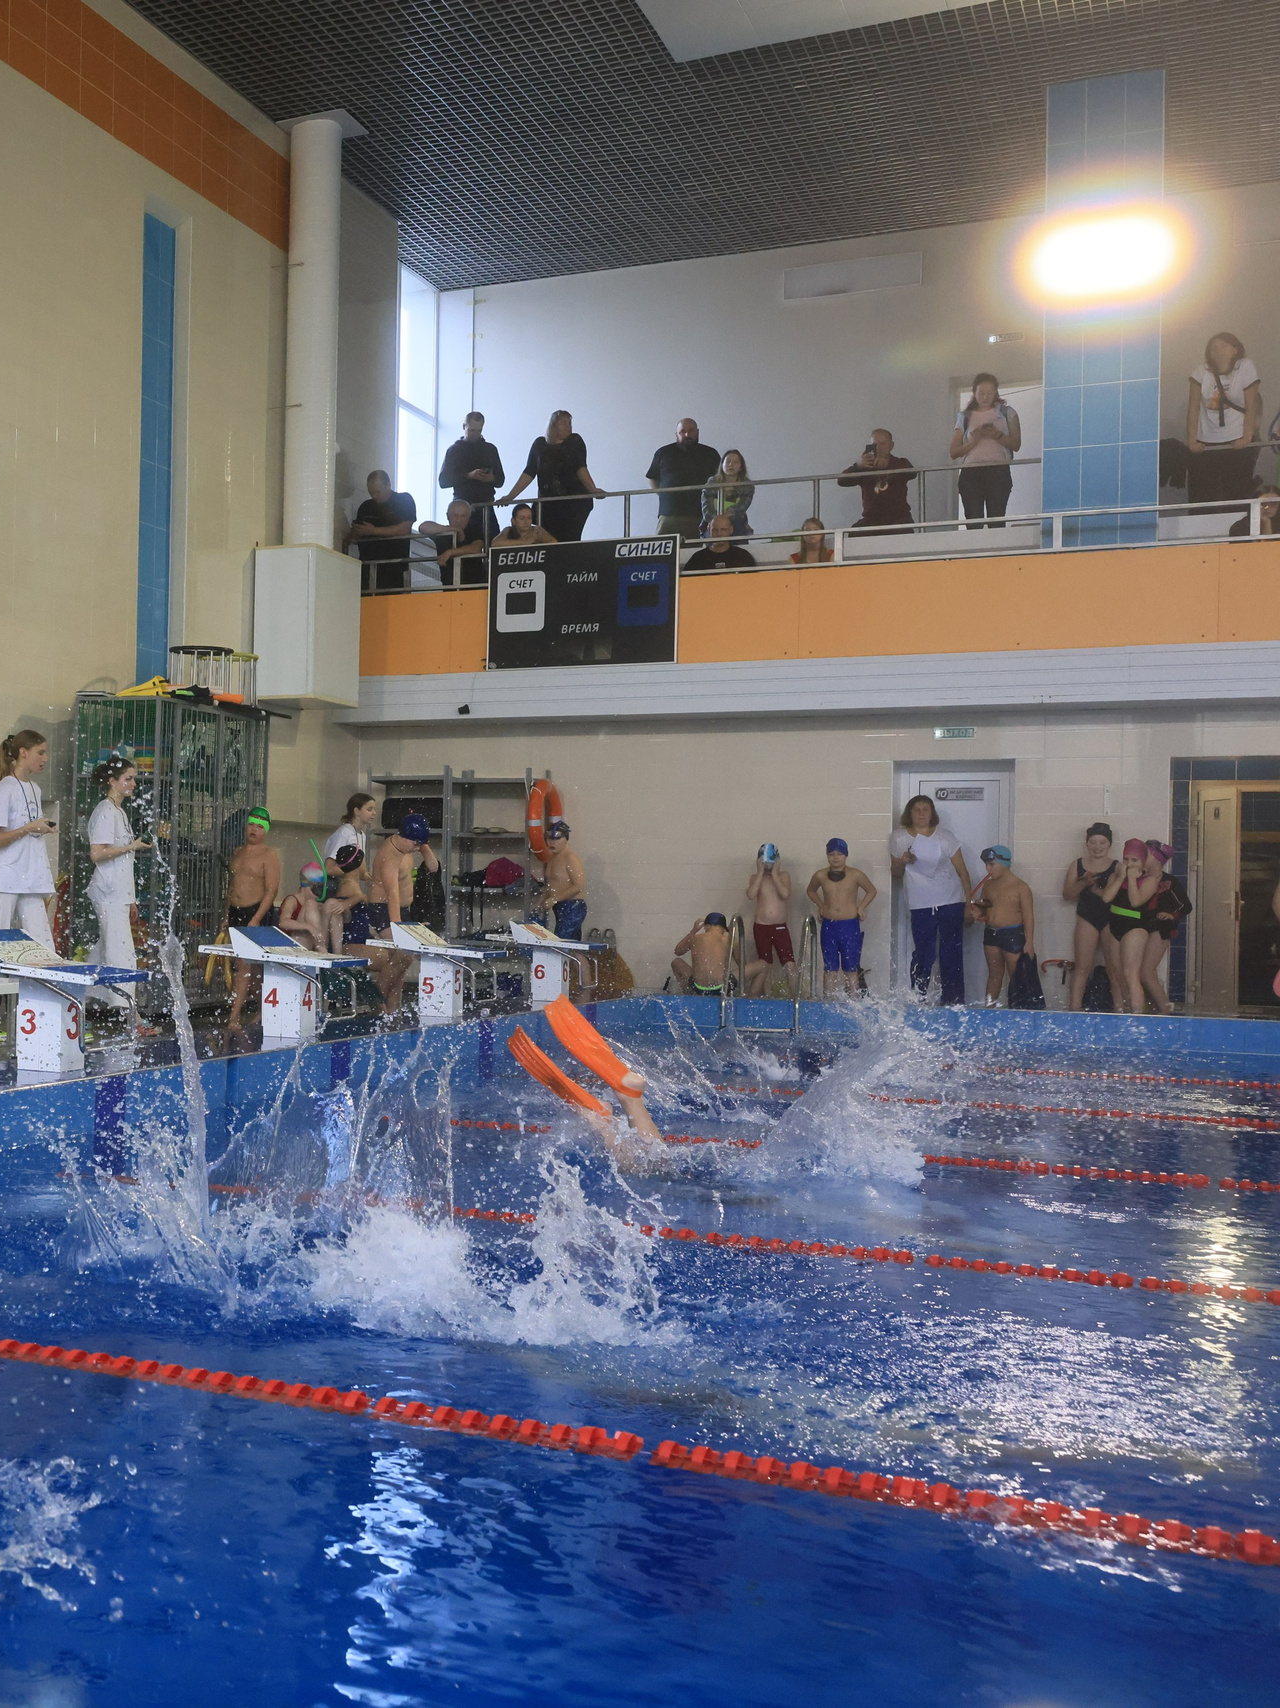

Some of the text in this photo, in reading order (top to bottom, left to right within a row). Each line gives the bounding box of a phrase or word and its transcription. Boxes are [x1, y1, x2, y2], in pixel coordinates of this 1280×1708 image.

[617, 540, 672, 557] СИНИЕ
[498, 550, 546, 566] БЕЛЫЕ
[508, 578, 534, 589] СЧЕТ
[566, 571, 598, 583] ТАЙМ
[630, 570, 658, 582] СЧЕТ
[561, 622, 600, 634] ВРЕМЯ
[935, 728, 974, 738] ВЫХОД
[534, 964, 545, 980] 6
[562, 960, 568, 983] 6
[421, 977, 434, 994] 5
[454, 969, 462, 995] 5
[264, 987, 279, 1008] 4
[302, 981, 313, 1011] 4
[20, 1008, 36, 1035] 3
[66, 1002, 79, 1040] 3
